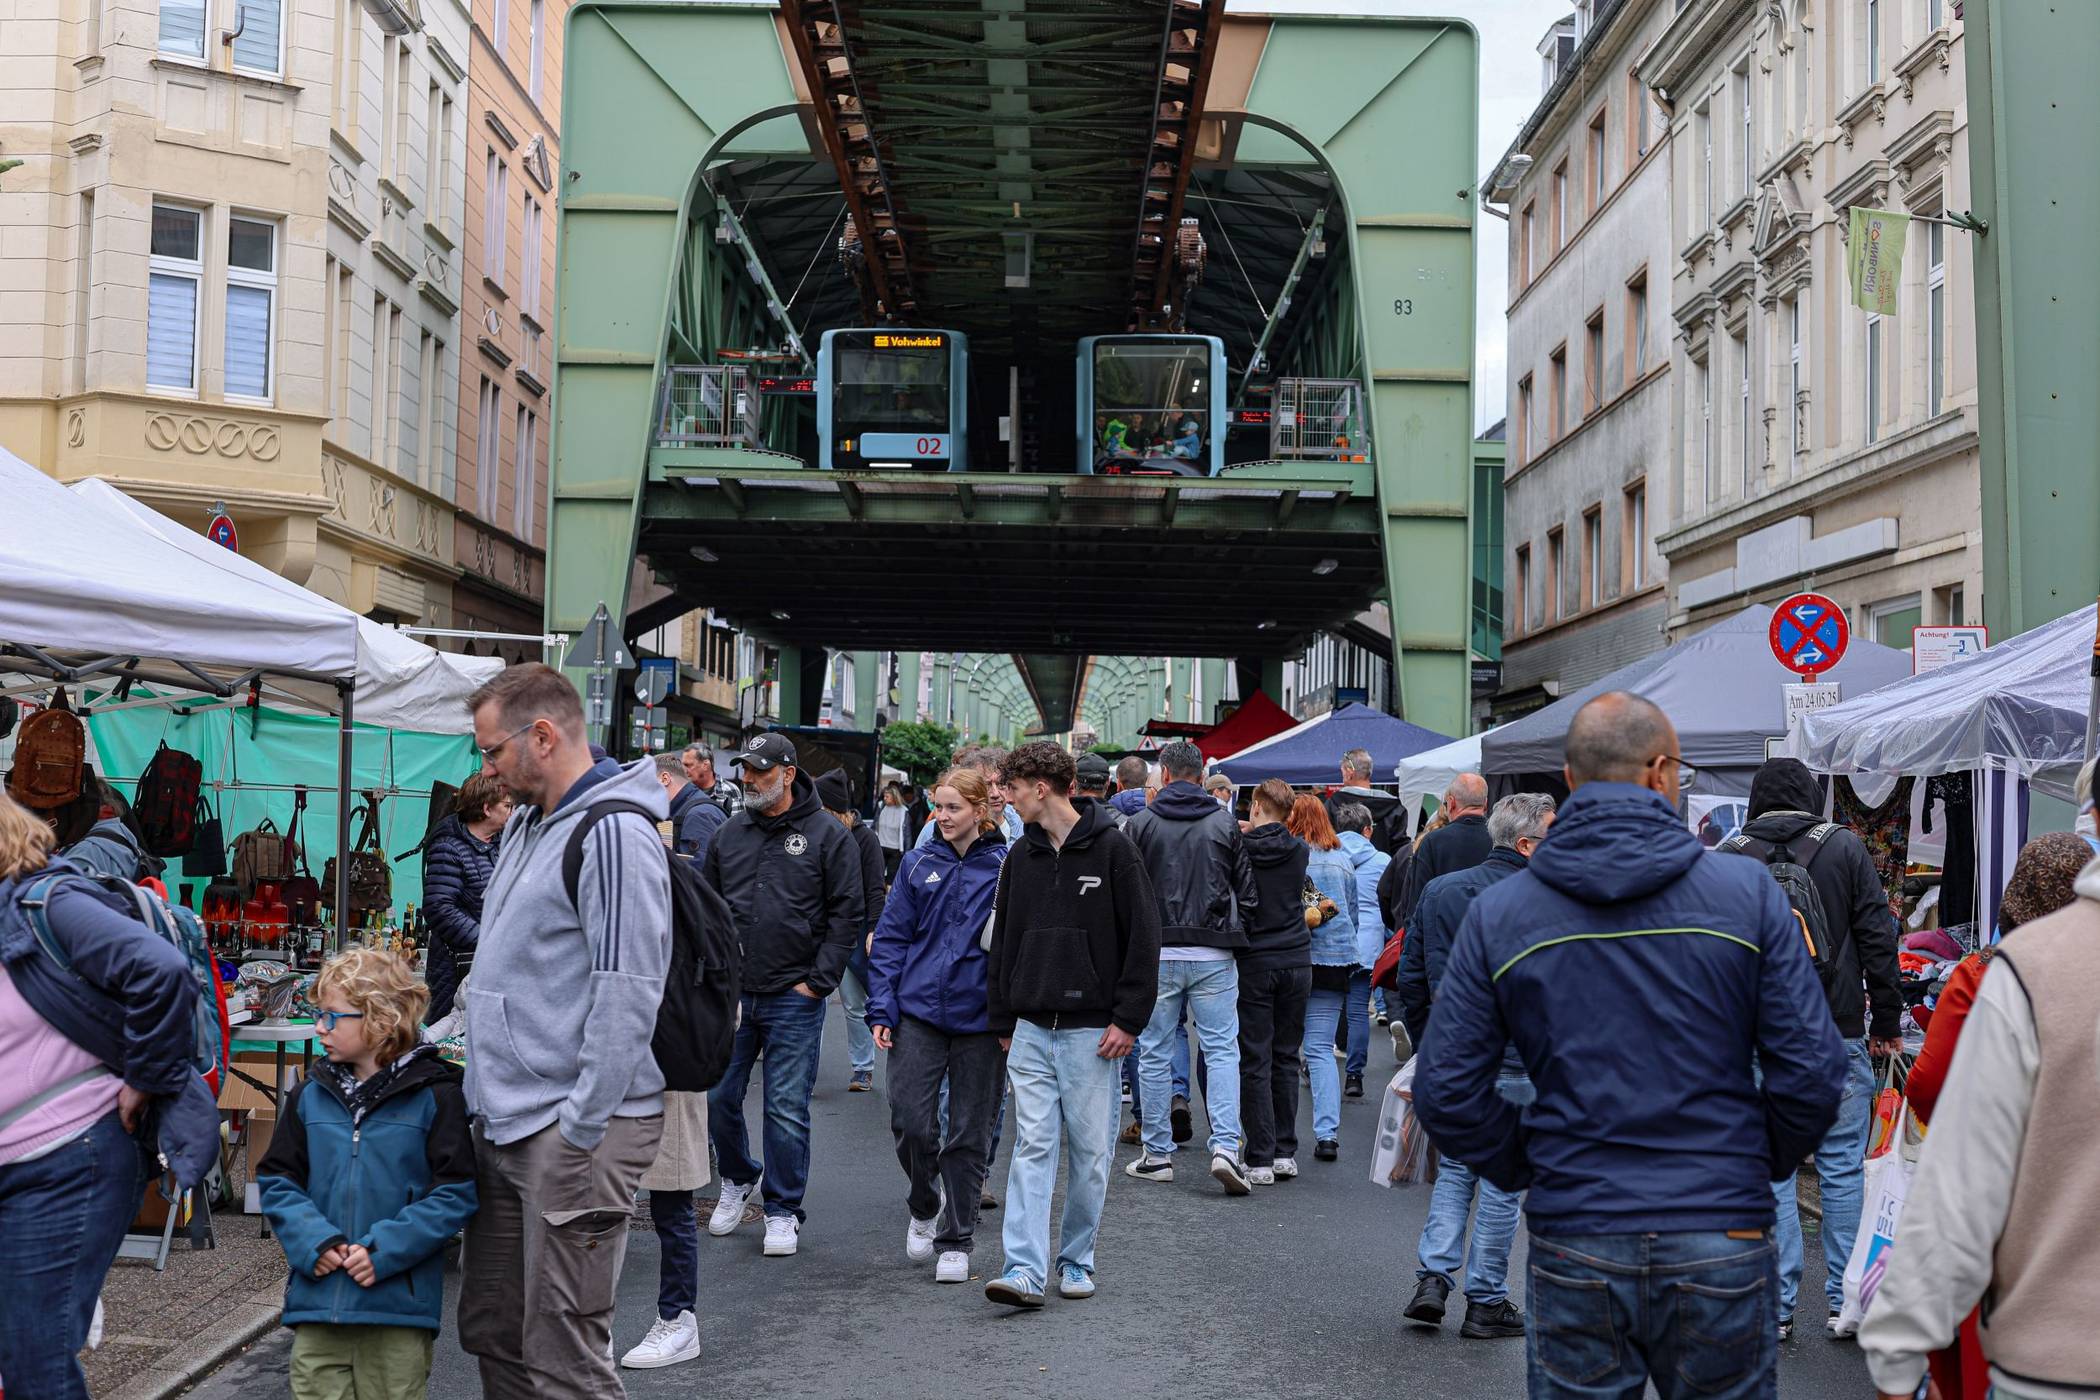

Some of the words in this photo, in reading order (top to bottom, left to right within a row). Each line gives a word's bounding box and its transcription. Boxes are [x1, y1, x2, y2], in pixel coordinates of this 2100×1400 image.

[1394, 299, 1412, 315] 83
[890, 336, 941, 347] Vohwinkel
[845, 439, 851, 452] 1
[917, 438, 941, 454] 02
[1789, 695, 1804, 709] Am
[1805, 692, 1837, 708] 24.05.25
